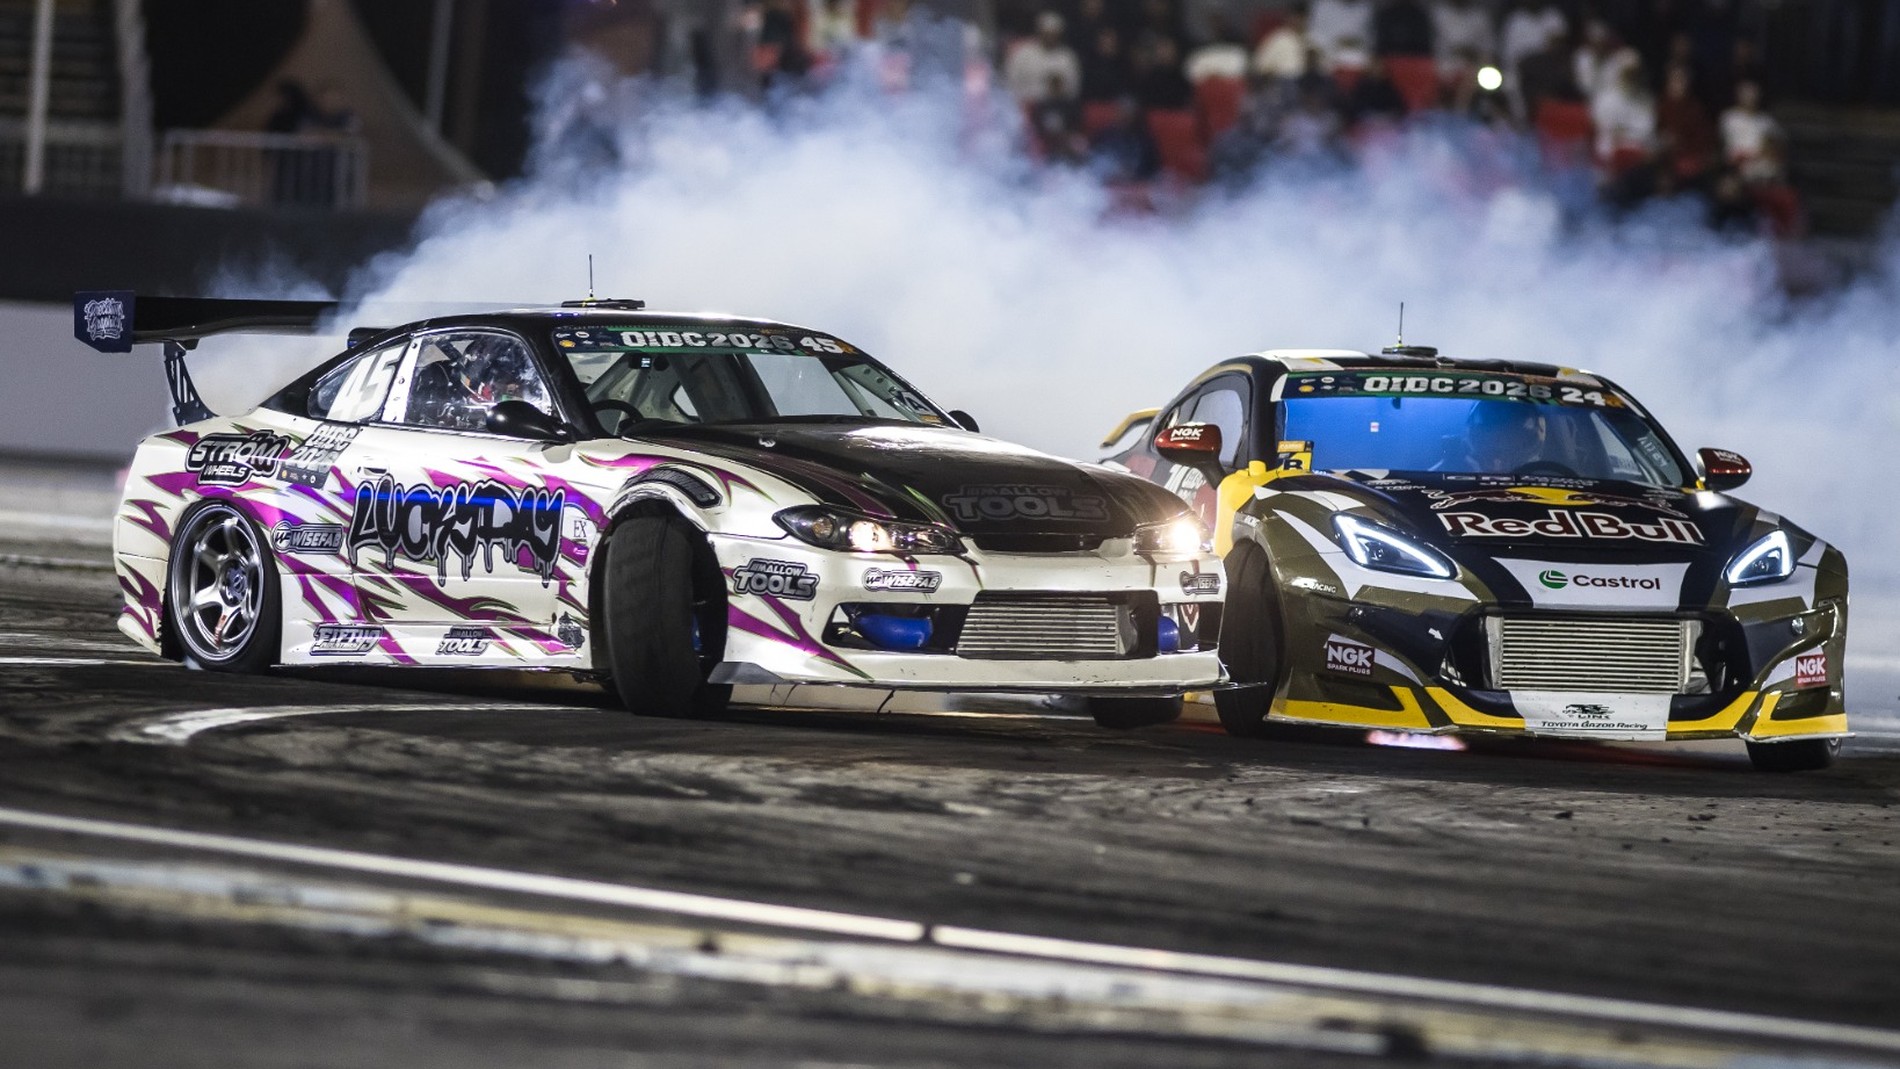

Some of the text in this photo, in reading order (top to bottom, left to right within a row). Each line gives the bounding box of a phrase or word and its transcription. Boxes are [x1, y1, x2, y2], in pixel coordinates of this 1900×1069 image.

[707, 333, 795, 350] 2026
[800, 336, 844, 354] 45
[326, 344, 405, 422] 45
[1363, 376, 1454, 392] OIDC
[1458, 379, 1552, 399] 2026
[1561, 387, 1606, 407] 24
[203, 465, 247, 478] WHEELS
[950, 496, 1105, 517] TOOLS
[1437, 509, 1705, 546] Red Bull
[292, 530, 341, 547] WISEFAB
[737, 571, 815, 596] TOOLS
[883, 575, 939, 588] WISEFAB
[1573, 575, 1660, 590] Castrol
[438, 639, 490, 652] TOOLS
[1327, 644, 1373, 668] NGK
[1326, 662, 1371, 675] SPARK PLUGS
[1797, 656, 1826, 677] NGK
[1541, 720, 1579, 728] TOYOTA
[1616, 722, 1648, 731] Racing
